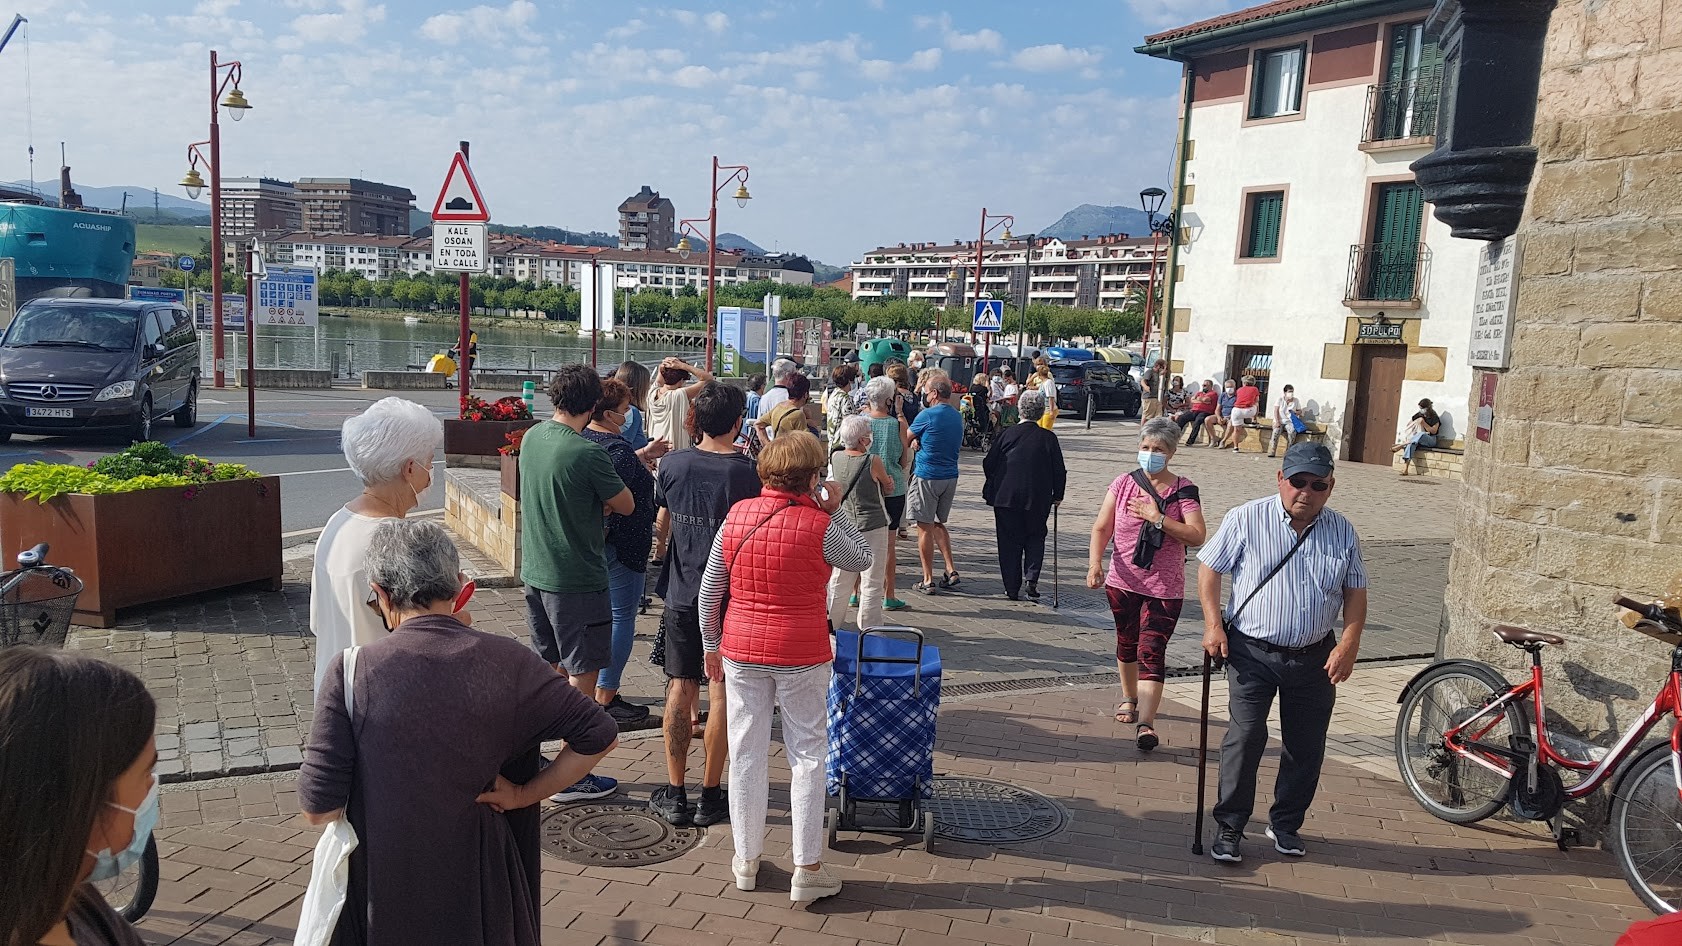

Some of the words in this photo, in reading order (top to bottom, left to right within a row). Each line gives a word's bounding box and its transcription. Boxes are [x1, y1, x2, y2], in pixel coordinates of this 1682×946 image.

[73, 222, 112, 232] AQUASHIP
[447, 227, 468, 235] KALE
[444, 237, 473, 245] OSOAN
[440, 248, 451, 256] EN
[455, 249, 477, 257] TODA
[438, 258, 449, 266] LA
[453, 259, 479, 267] CALLE
[32, 408, 53, 416] 3472
[55, 409, 71, 417] HTS
[672, 511, 704, 526] THERE
[979, 829, 1007, 839] DE
